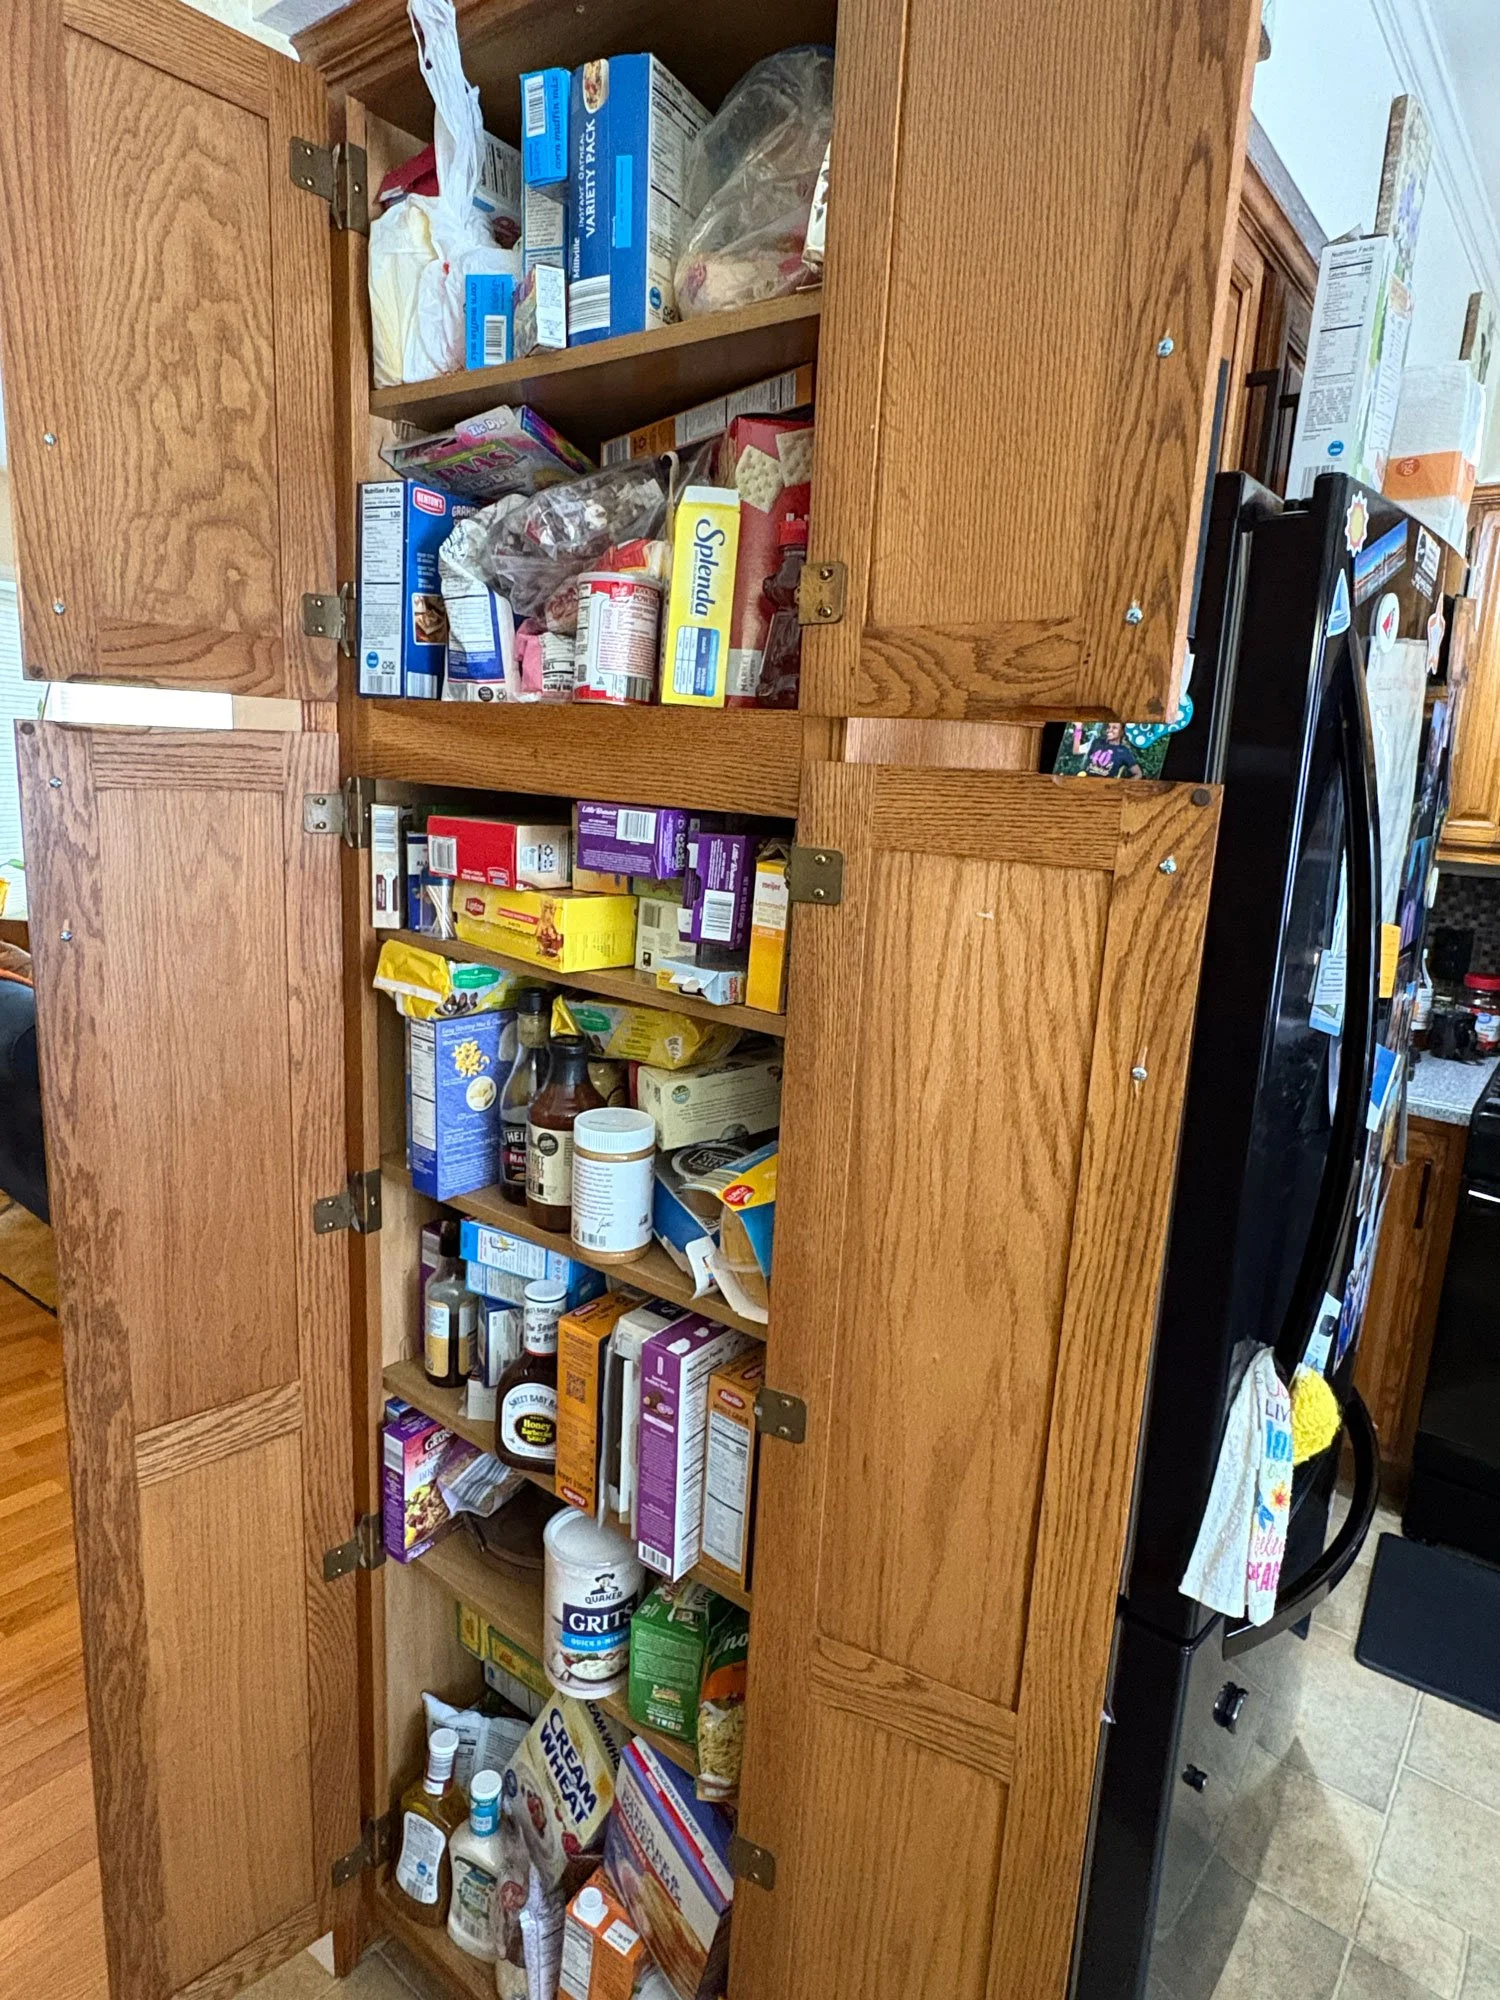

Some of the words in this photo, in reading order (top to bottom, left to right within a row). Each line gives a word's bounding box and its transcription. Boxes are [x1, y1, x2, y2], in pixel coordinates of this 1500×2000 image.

[585, 118, 596, 165] PACK
[585, 168, 596, 238] VARIETY
[434, 449, 518, 483] PAAS
[693, 518, 726, 617] Splenda
[467, 900, 484, 912] Lipton
[507, 1131, 527, 1143] HEI
[523, 1419, 551, 1433] Honey
[526, 1435, 547, 1443] Sauce
[584, 1592, 623, 1605] QUAKER
[568, 1603, 634, 1633] GRITS
[540, 1722, 589, 1824] WHEAT
[549, 1708, 597, 1814] CREAM
